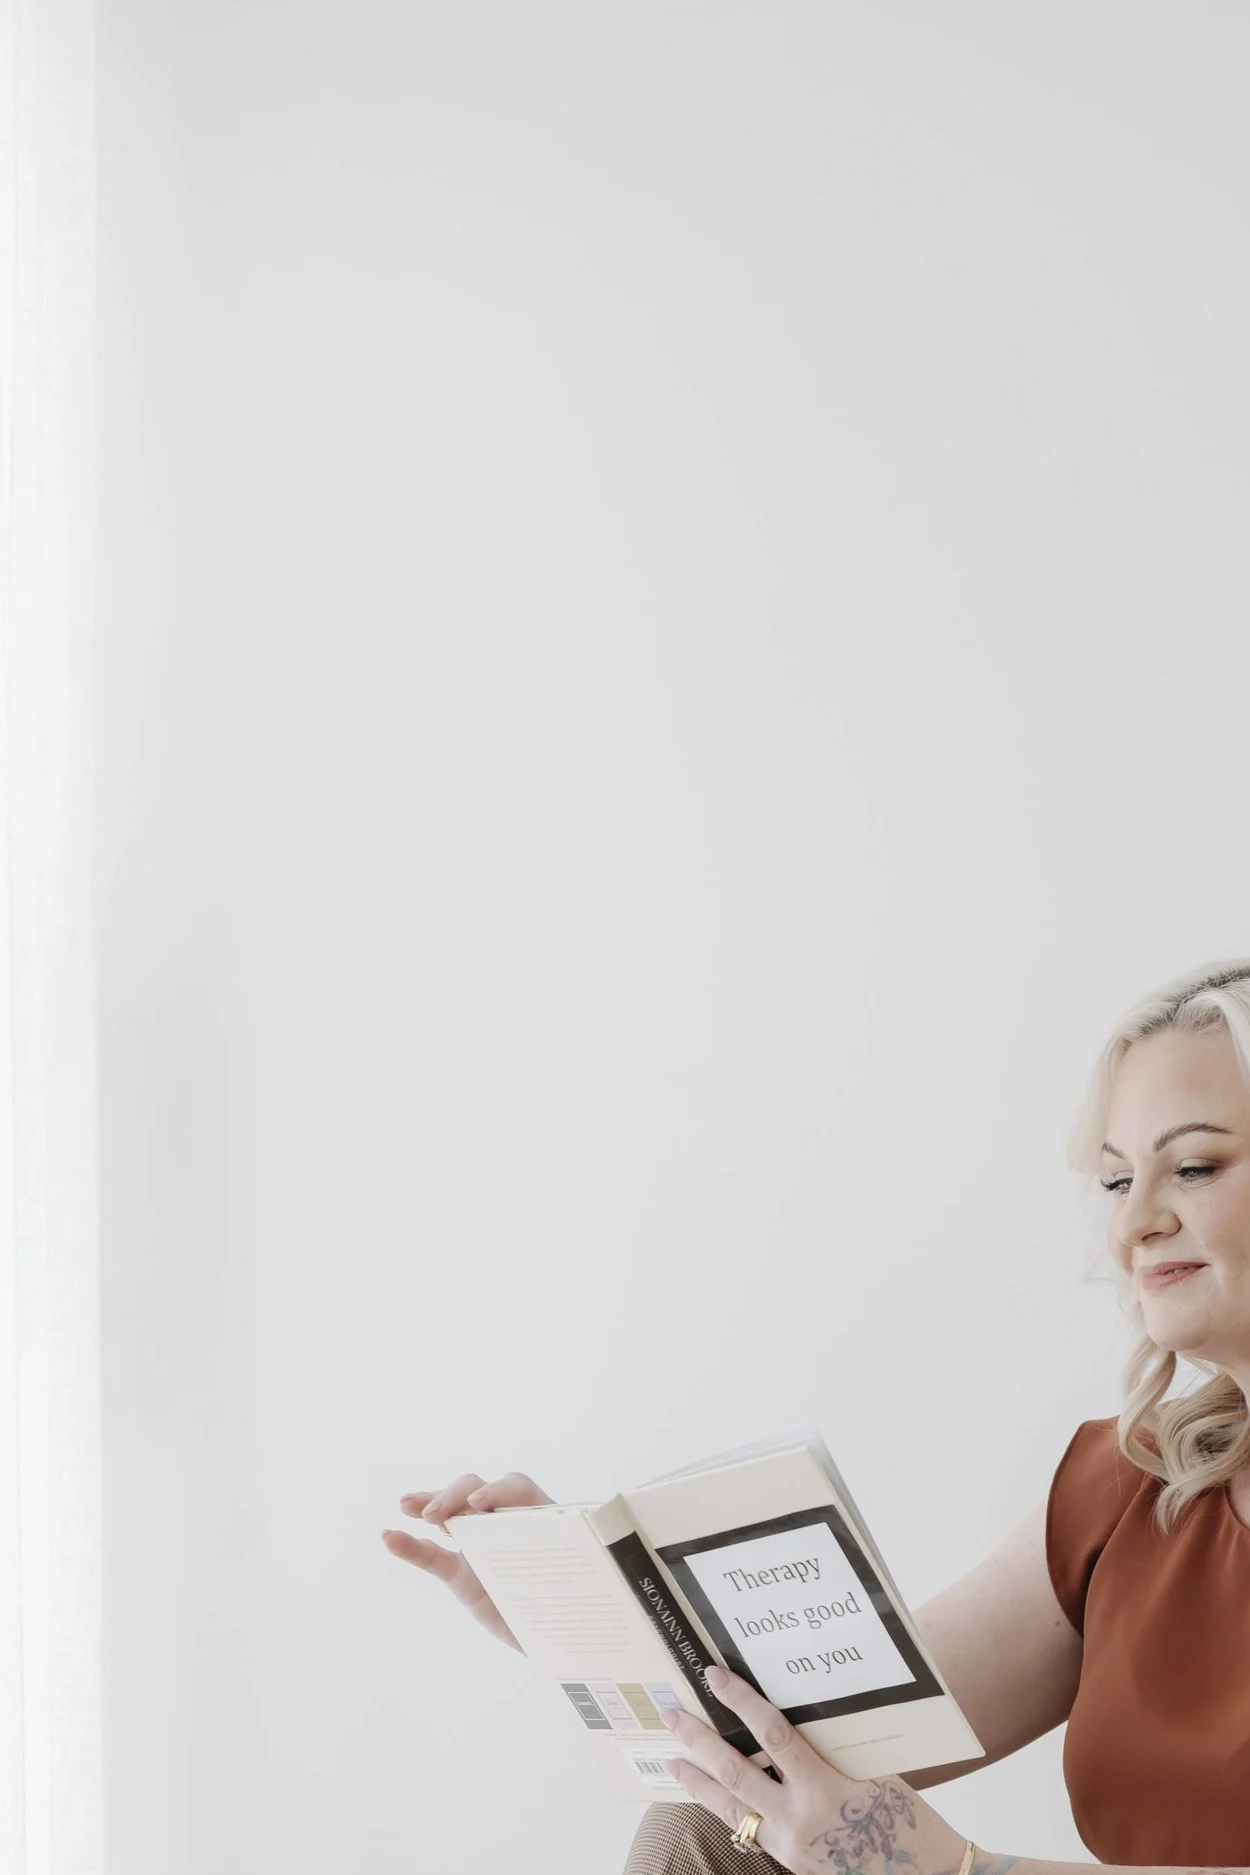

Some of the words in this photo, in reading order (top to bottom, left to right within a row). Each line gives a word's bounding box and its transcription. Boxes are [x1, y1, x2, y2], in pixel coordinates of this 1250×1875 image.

[723, 1553, 821, 1593] Therapy
[734, 1610, 800, 1639] looks
[804, 1591, 863, 1631] good
[786, 1658, 817, 1676] on
[817, 1645, 865, 1675] you
